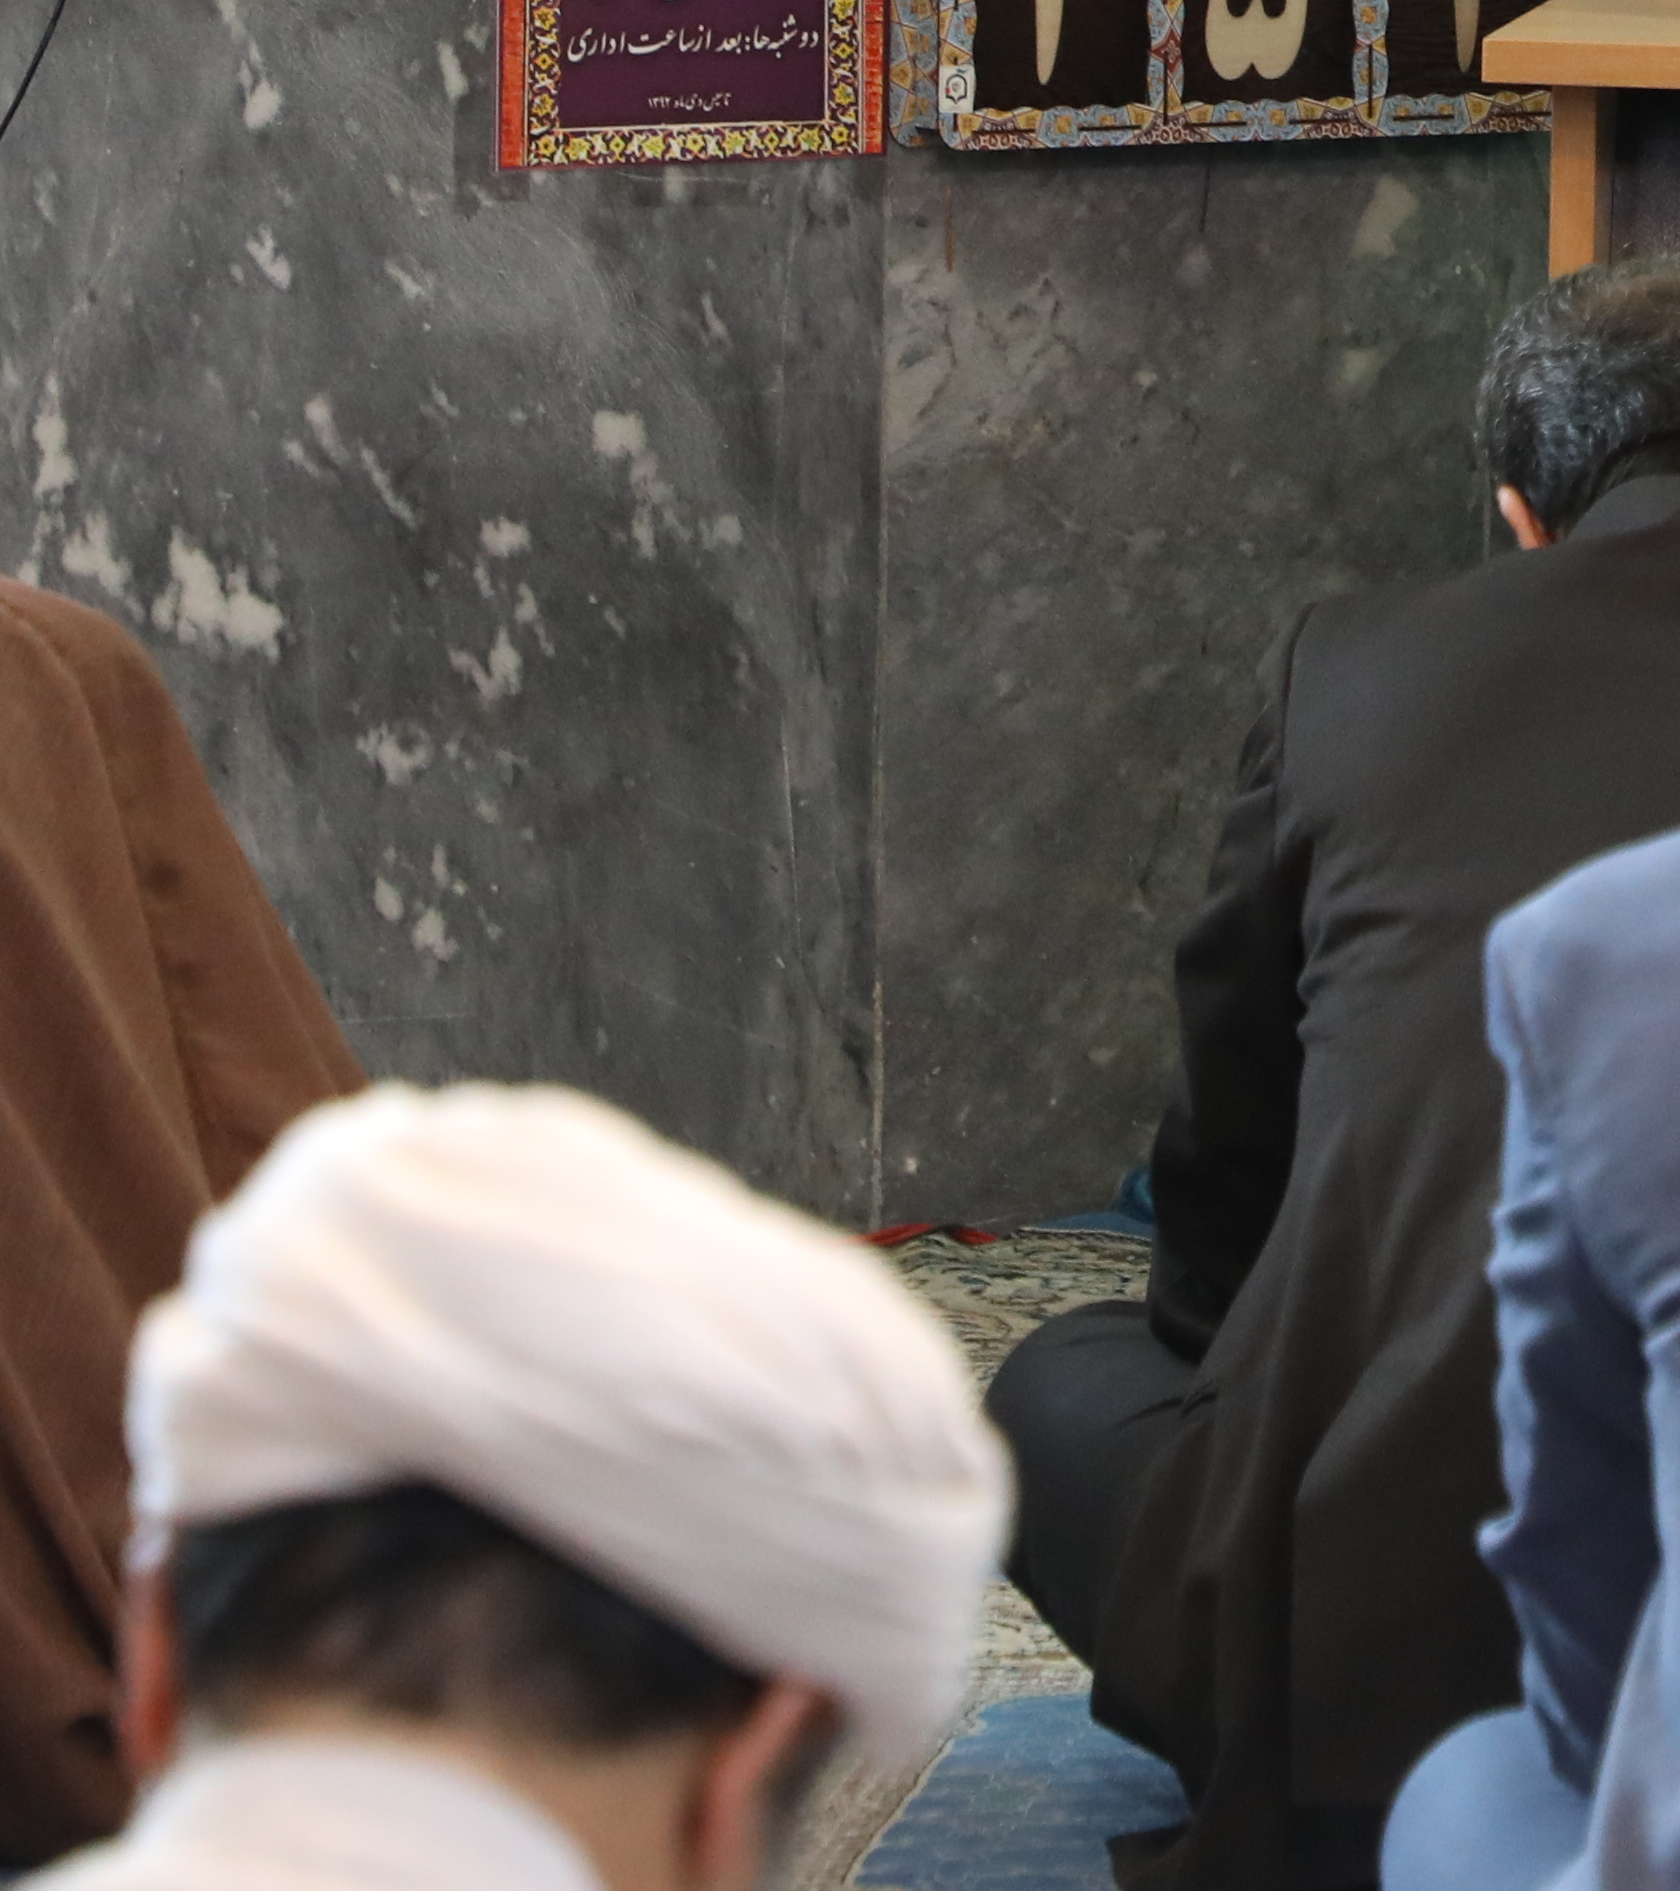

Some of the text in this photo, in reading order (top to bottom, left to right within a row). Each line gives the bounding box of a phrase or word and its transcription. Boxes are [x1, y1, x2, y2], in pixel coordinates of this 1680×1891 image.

[567, 27, 626, 62] اداری
[627, 27, 695, 55] ساعت
[694, 24, 712, 52] از
[715, 32, 742, 54] بعد
